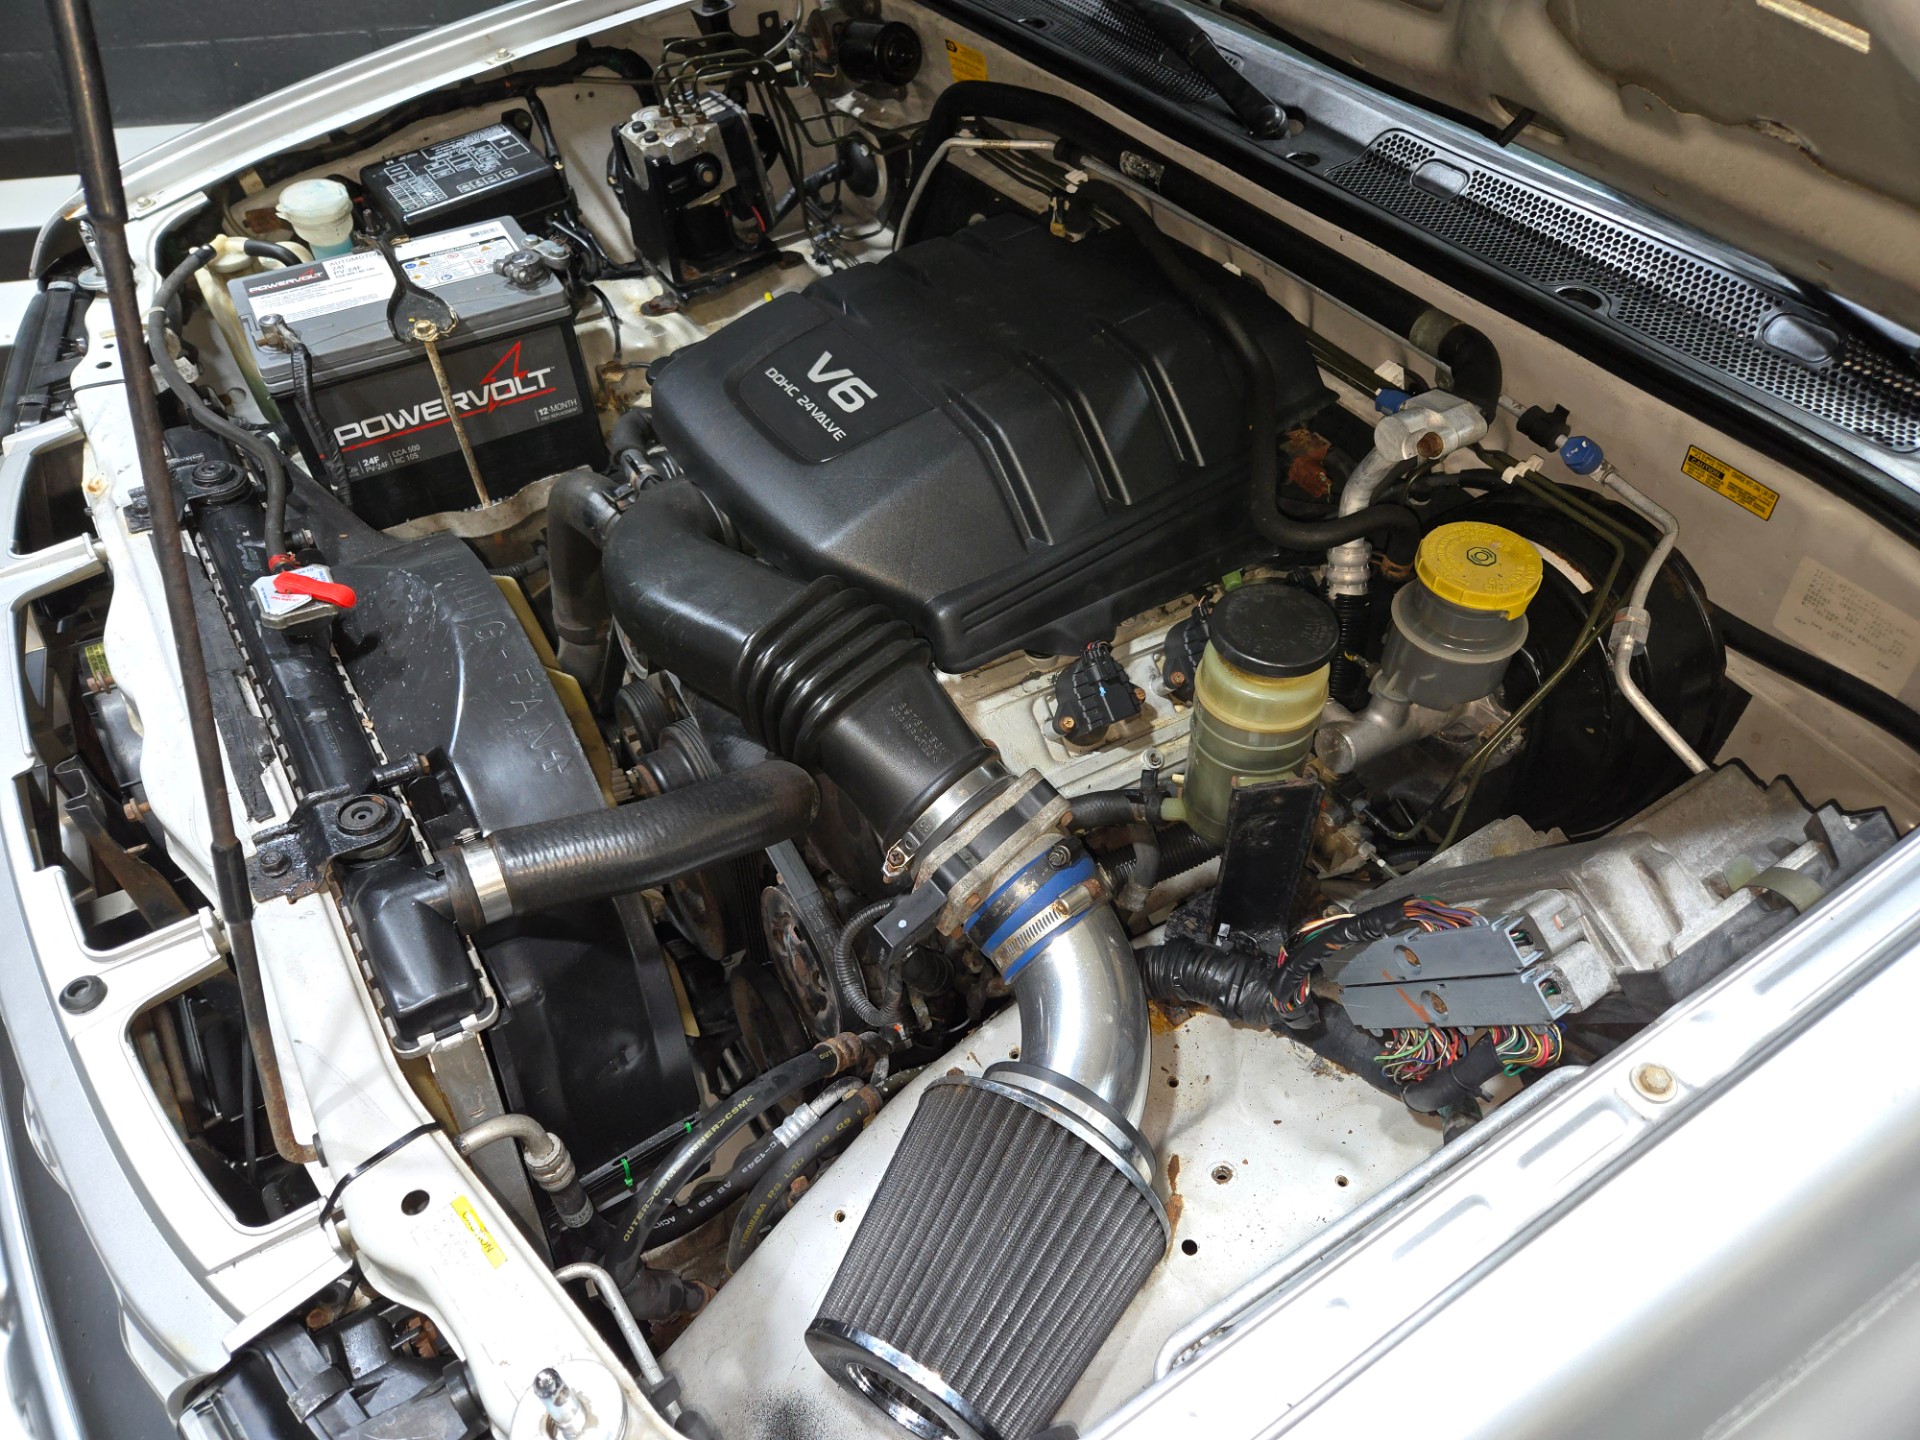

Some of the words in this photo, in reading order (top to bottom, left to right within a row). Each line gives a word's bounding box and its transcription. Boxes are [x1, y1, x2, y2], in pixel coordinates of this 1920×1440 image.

[329, 251, 377, 267] AUTOMOTIV
[248, 270, 323, 294] POWERVOLT
[764, 366, 800, 398] DOHC
[807, 350, 878, 413] V6
[333, 367, 551, 446] POWERVOLT
[538, 398, 577, 417] 12-MONTH
[392, 448, 407, 458] CCA
[407, 444, 421, 453] 500
[394, 456, 406, 465] RC
[362, 455, 380, 467] 24F
[365, 460, 389, 473] PV-24F
[1690, 456, 1721, 478] CAUTION
[767, 1182, 782, 1200] PS
[462, 1207, 495, 1254] CUON
